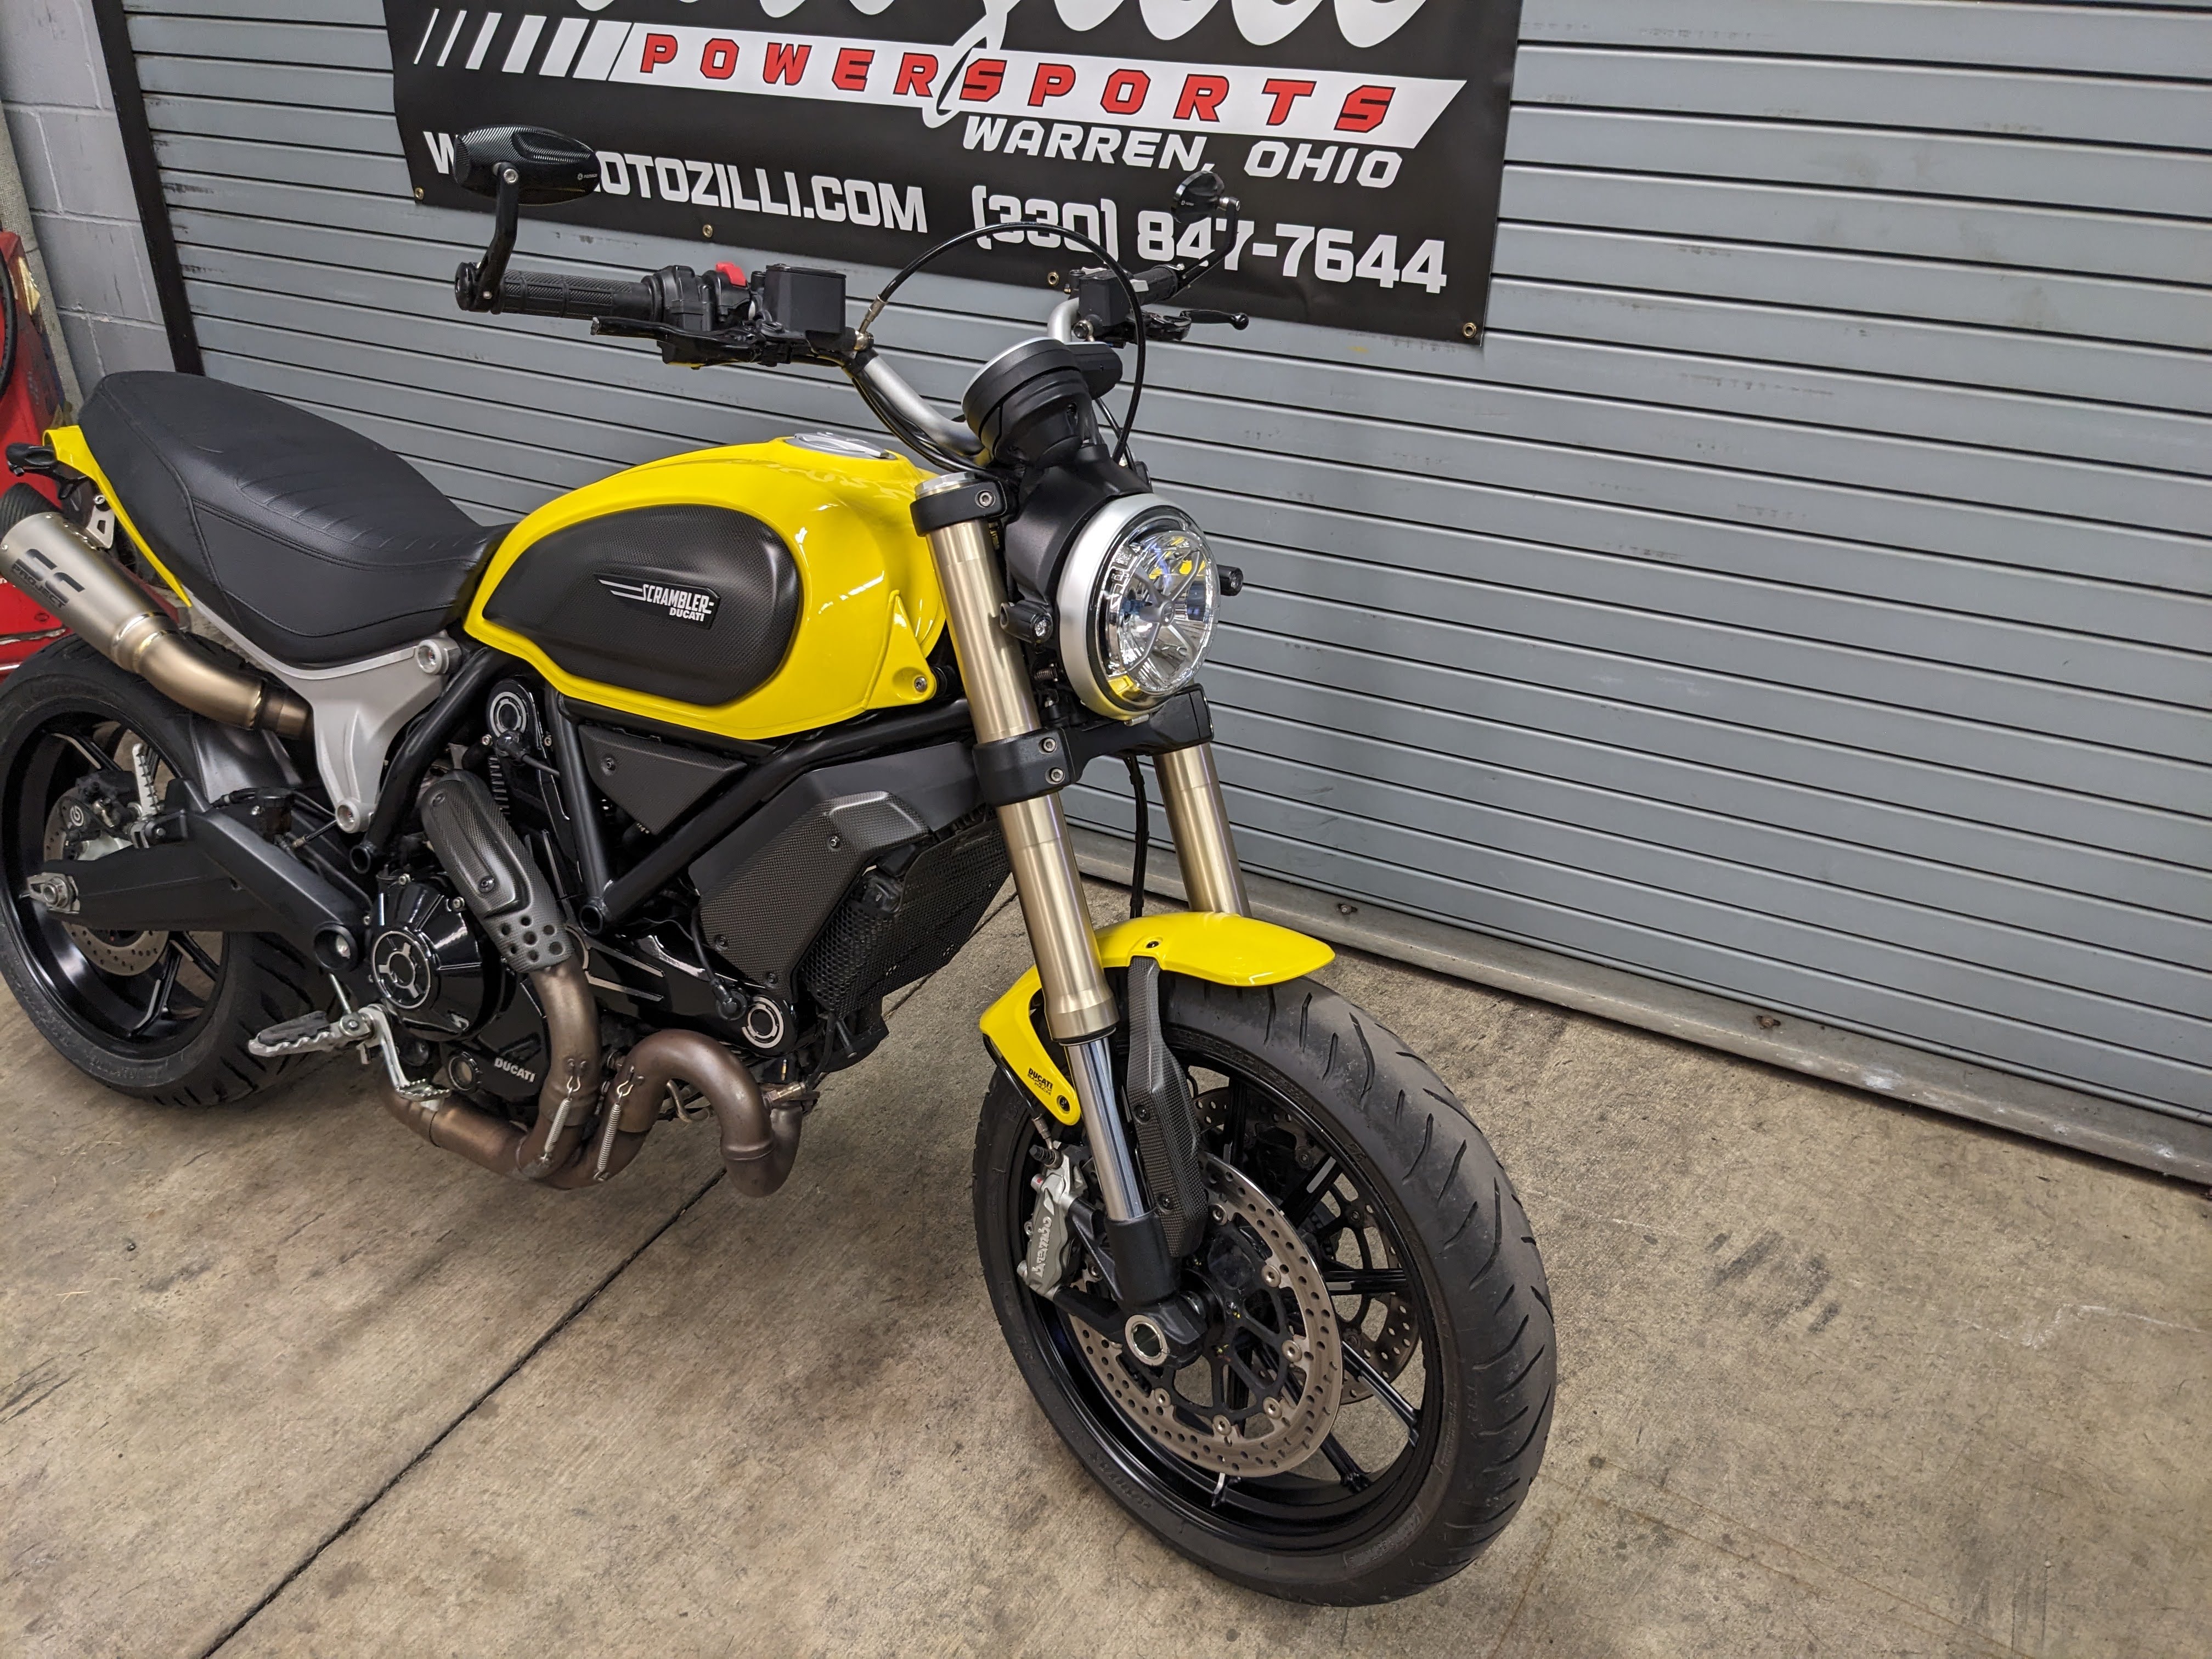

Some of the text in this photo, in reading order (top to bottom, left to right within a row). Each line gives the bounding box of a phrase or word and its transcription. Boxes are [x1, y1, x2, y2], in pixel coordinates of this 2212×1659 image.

[640, 33, 1396, 132] POWERSPORTS
[963, 116, 1402, 188] WARREN, OHIO
[972, 185, 1119, 264] (330)
[669, 607, 705, 622] DUCATI
[494, 1057, 536, 1082] DUCATI
[1028, 1068, 1053, 1089] DUCATI
[1032, 1216, 1052, 1278] brembo
